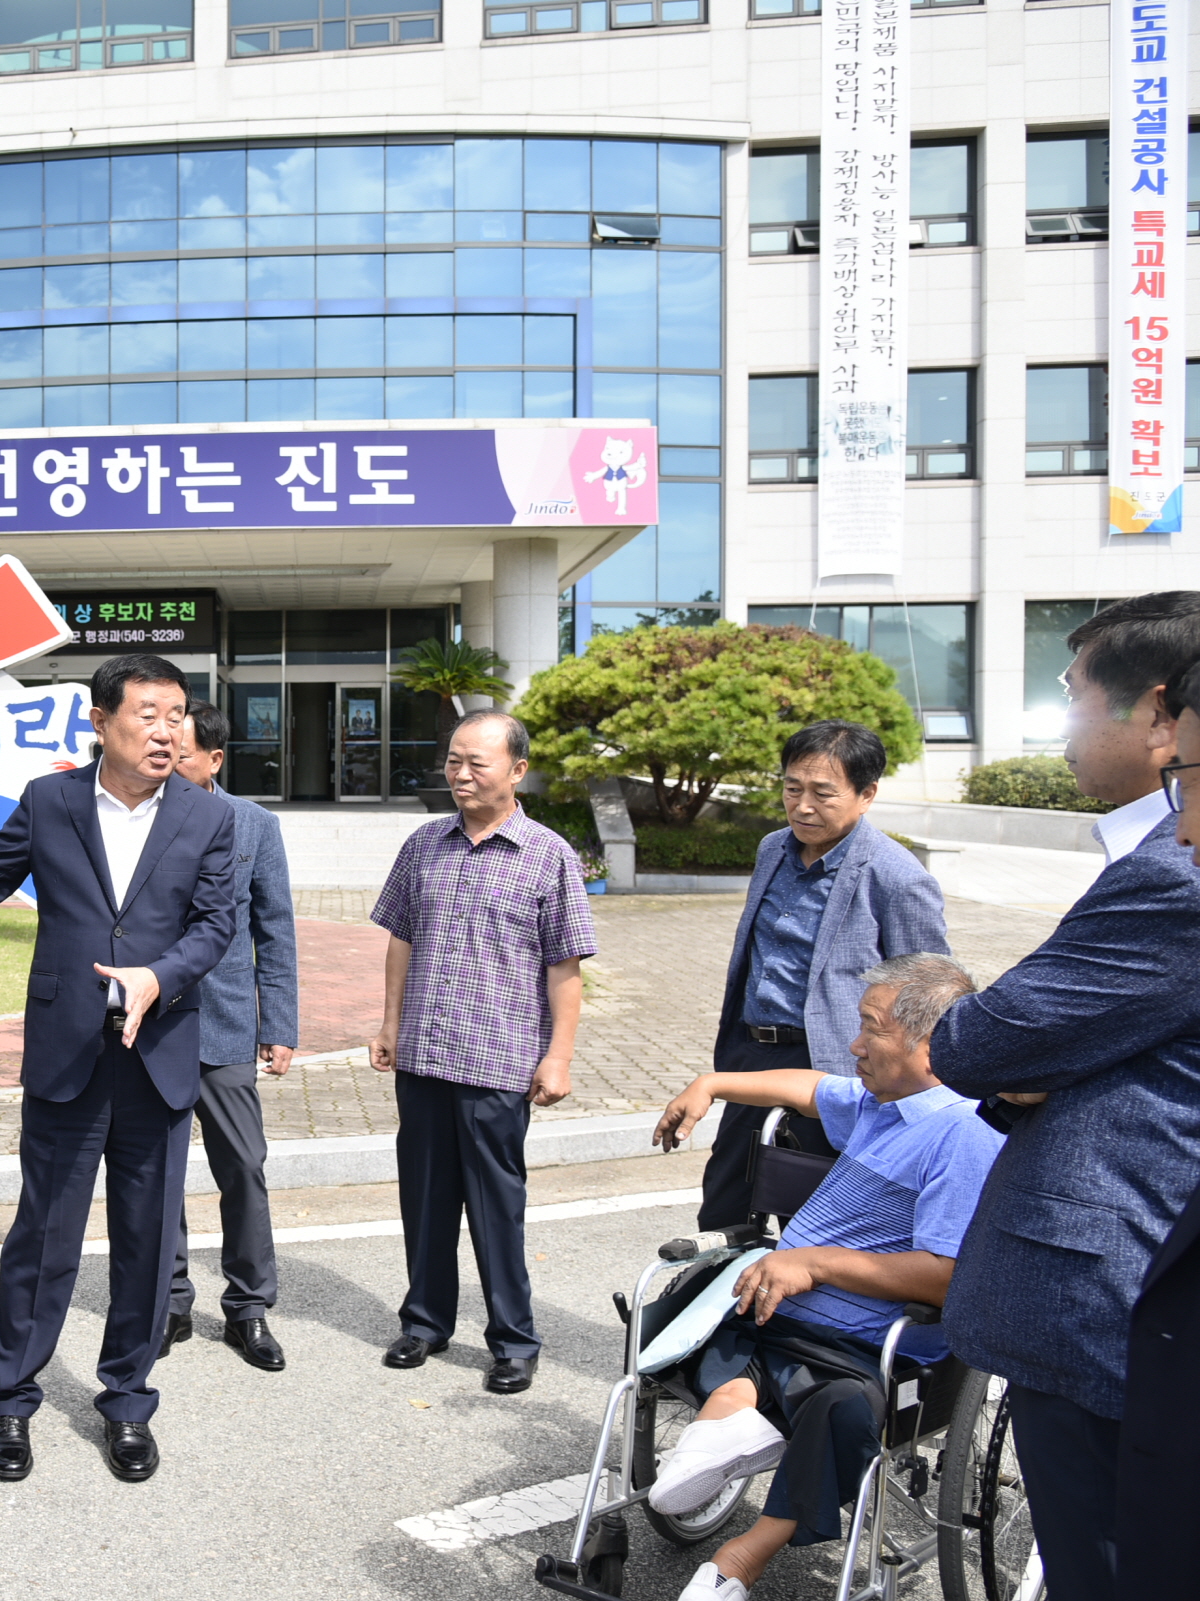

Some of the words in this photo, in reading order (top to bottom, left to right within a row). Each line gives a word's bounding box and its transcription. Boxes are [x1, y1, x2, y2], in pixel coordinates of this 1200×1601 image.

[1131, 0, 1168, 63] 도교
[835, 62, 862, 131] 땅입니다.
[872, 66, 898, 134] 사지말자.
[1131, 77, 1169, 195] 건설공사
[872, 154, 898, 200] 방사능
[871, 210, 898, 287] 일본섬나라
[1131, 211, 1166, 298] 특교세
[871, 298, 897, 366] 가지말자.
[1124, 316, 1169, 404] 15억원
[832, 364, 859, 393] 사과
[275, 442, 415, 512] 진도
[1130, 420, 1164, 476] 확보
[524, 502, 568, 515] Jindo
[74, 604, 92, 623] 상
[99, 603, 153, 622] 후보자
[160, 602, 196, 621] 추천
